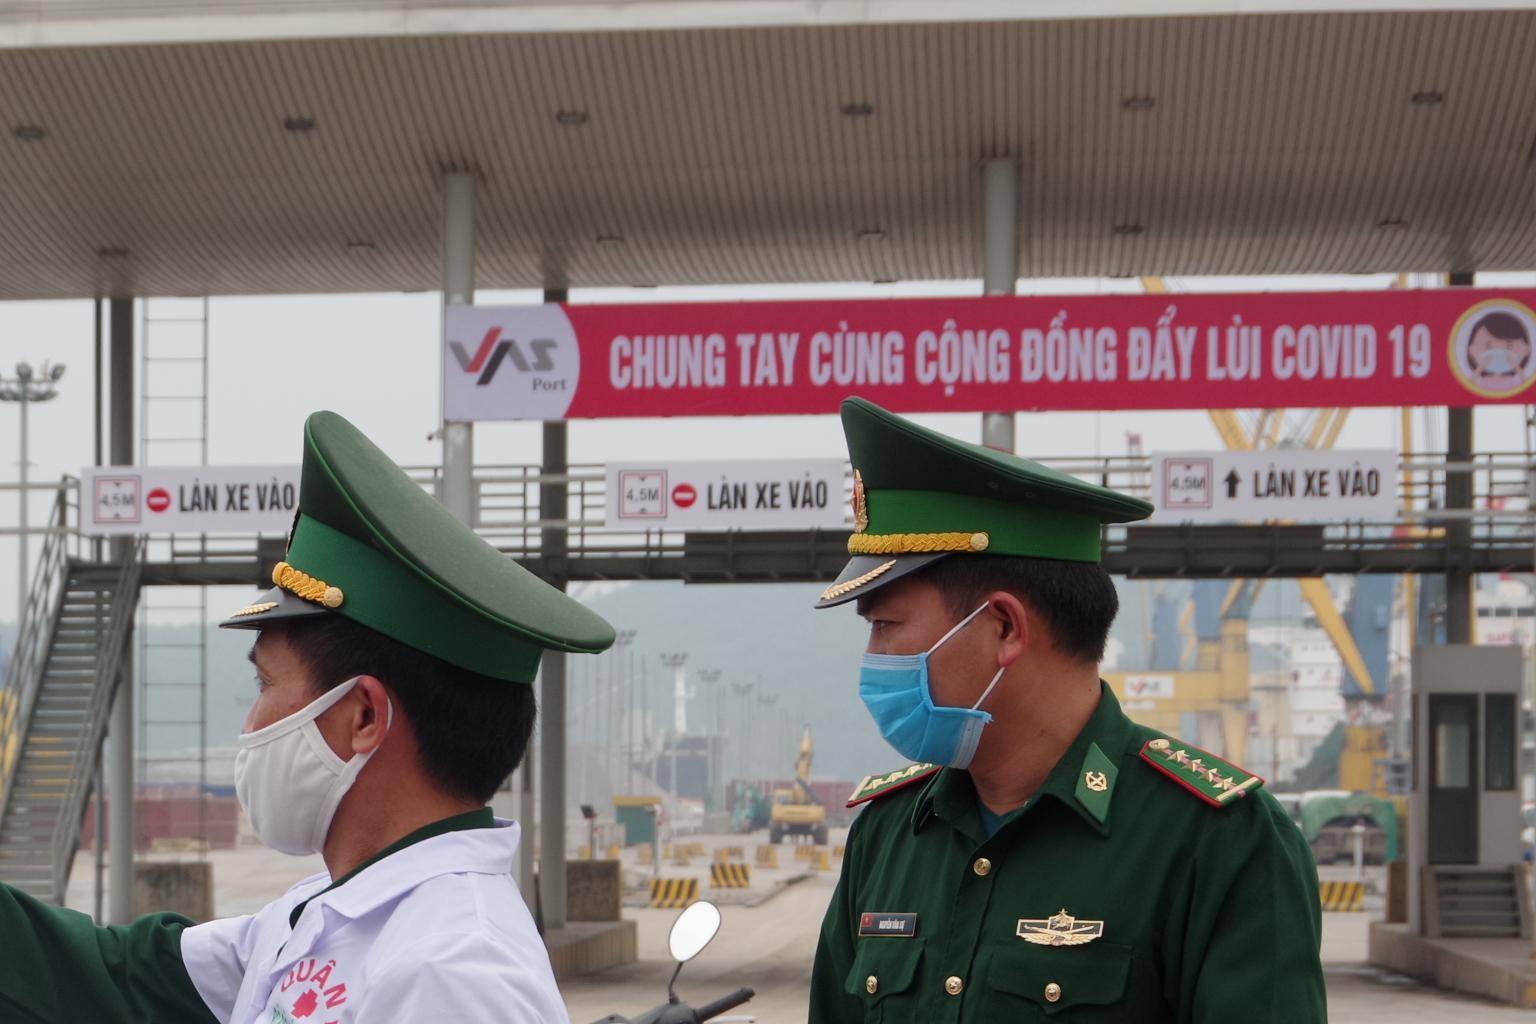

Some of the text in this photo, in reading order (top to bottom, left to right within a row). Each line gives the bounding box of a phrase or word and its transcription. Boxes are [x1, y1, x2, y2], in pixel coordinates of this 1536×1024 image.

[609, 304, 1432, 397] CHUNG TAY CÙNG CỘNG ĐỒNG ĐẨY LÙI COVID 19
[532, 377, 567, 391] Port
[179, 476, 295, 513] LÀN XE VÀO
[706, 472, 828, 510] LÀN XE VÀO
[1253, 461, 1381, 499] LÀN XE VÀO
